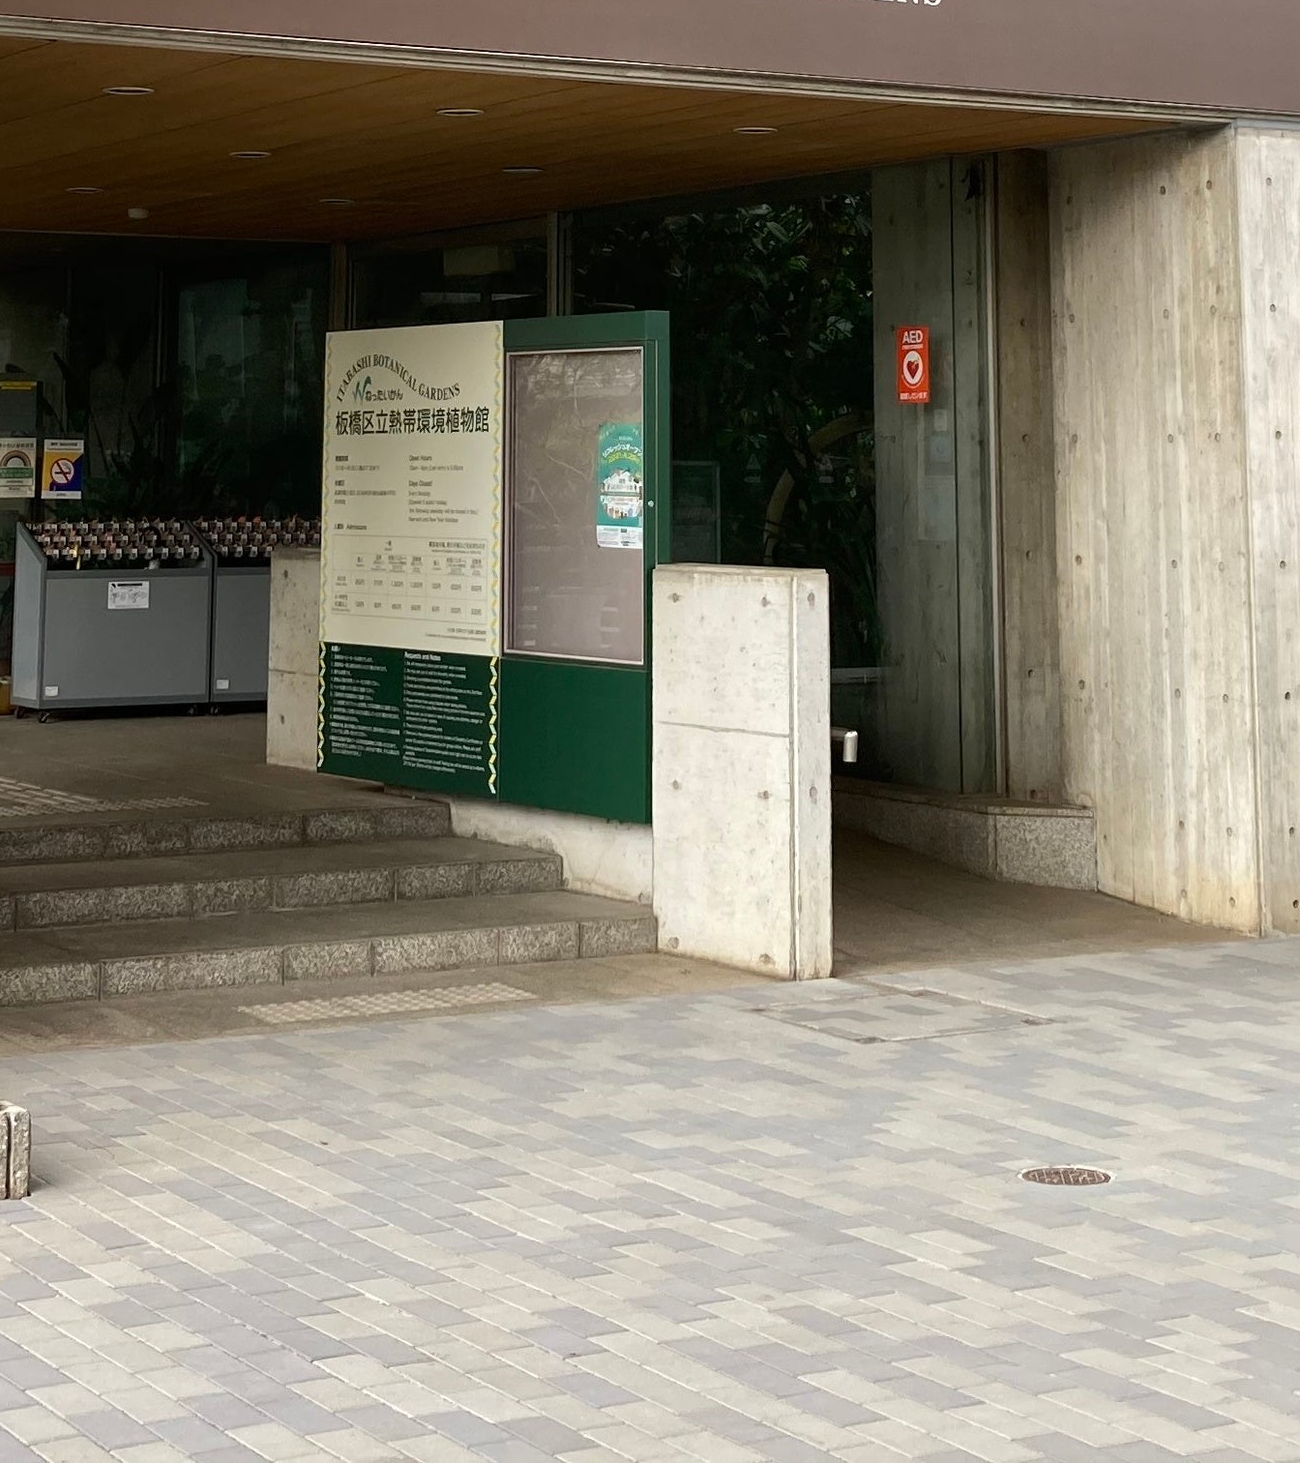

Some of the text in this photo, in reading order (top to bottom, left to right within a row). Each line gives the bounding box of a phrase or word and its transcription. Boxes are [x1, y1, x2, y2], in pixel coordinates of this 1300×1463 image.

[902, 329, 923, 344] AED
[336, 354, 460, 403] ITABASHI BOTANICAL GARDENS
[335, 405, 490, 436] 板橋区立熱帯環境植物館
